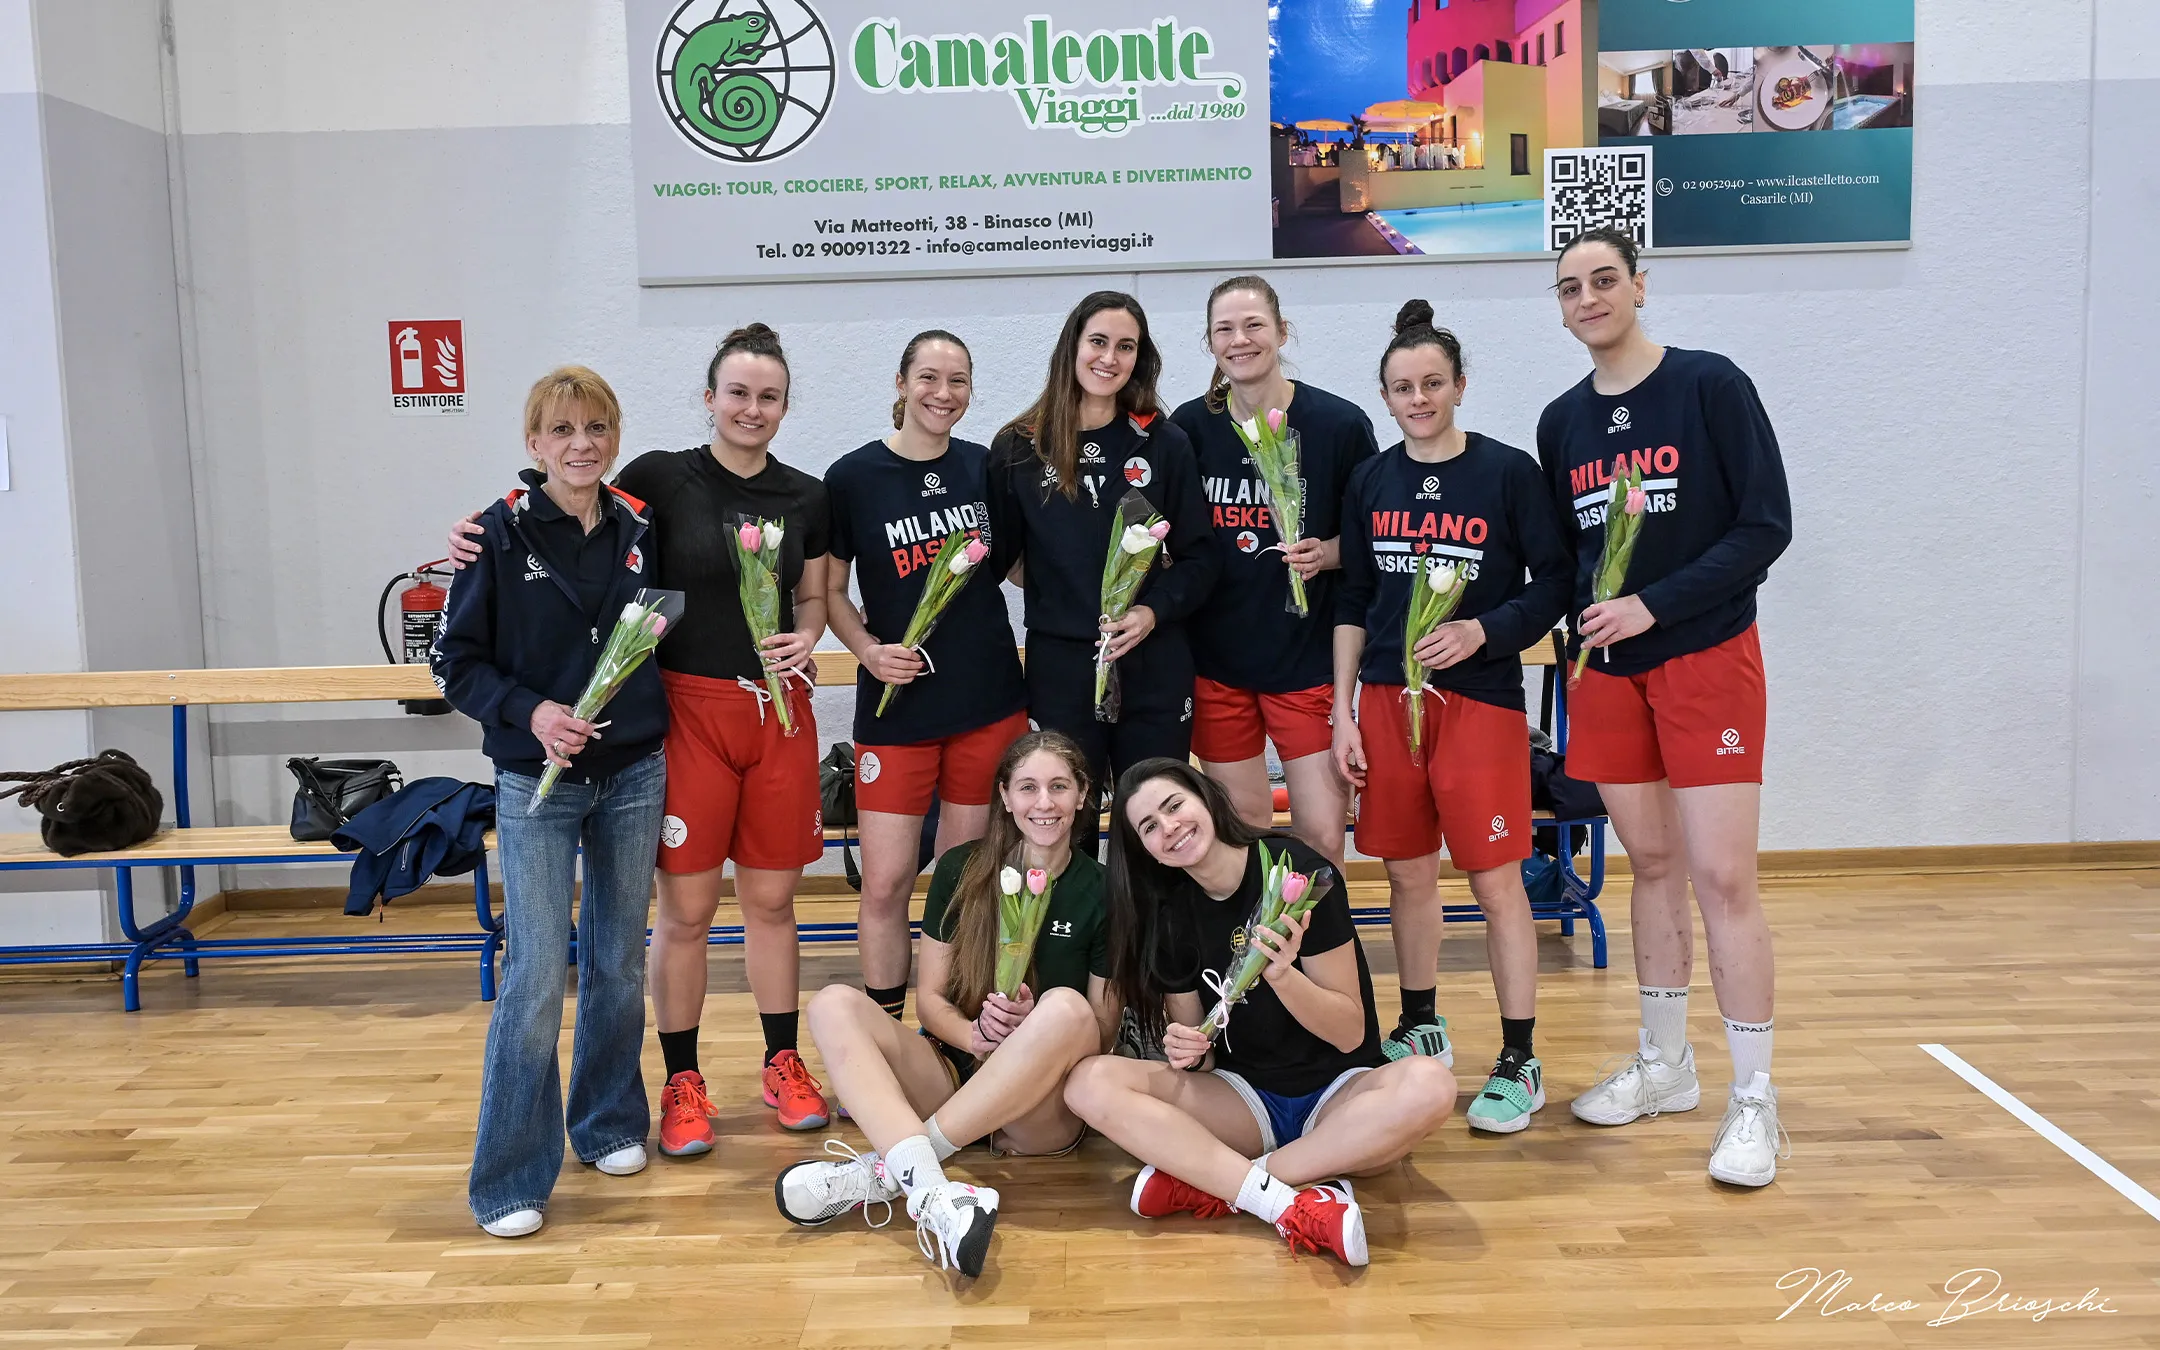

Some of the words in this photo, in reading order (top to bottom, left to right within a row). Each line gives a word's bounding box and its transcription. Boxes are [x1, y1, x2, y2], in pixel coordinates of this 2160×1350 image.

[854, 19, 1242, 98] Camaleonte
[1013, 87, 1141, 133] Viaggi
[1198, 103, 1246, 119] 1980
[653, 182, 722, 197] VIAGGI:
[726, 180, 778, 196] TOUR,
[783, 178, 868, 194] CROCIERE,
[874, 176, 934, 191] SPORT,
[939, 174, 998, 190] RELAX,
[1003, 170, 1107, 187] AVVENTURA
[1112, 170, 1121, 184] E
[1126, 166, 1252, 184] DIVERTIMENTO
[1682, 181, 1697, 190] 02
[1699, 179, 1745, 191] 9052940
[1756, 173, 1880, 188] www.ilcastelletto.com
[1740, 192, 1787, 205] Casarile
[1789, 191, 1814, 205] (MI)
[814, 219, 845, 234] Via
[851, 215, 938, 234] Matteotti,
[944, 215, 968, 231] 38
[984, 214, 1052, 230] Binasco
[1058, 210, 1094, 230] (MI)
[756, 243, 787, 259] Tel.
[792, 242, 815, 257] 02
[820, 240, 911, 257] 90091322
[926, 232, 1154, 255] info@camaleonteviaggi.it
[393, 395, 464, 408] ESTINTORE
[1607, 421, 1632, 434] BITRE
[1079, 456, 1107, 464] BITRE
[1569, 445, 1680, 496] MILANO
[921, 487, 948, 498] BITRE
[1201, 475, 1270, 505] MILAN
[1415, 492, 1442, 500] BITRE
[884, 503, 979, 549] MILANO
[1211, 505, 1270, 529] ASKE
[1371, 510, 1488, 545] MILANO
[524, 570, 549, 582] BITR
[1716, 746, 1746, 756] BITRE
[1488, 829, 1510, 843] BITRE
